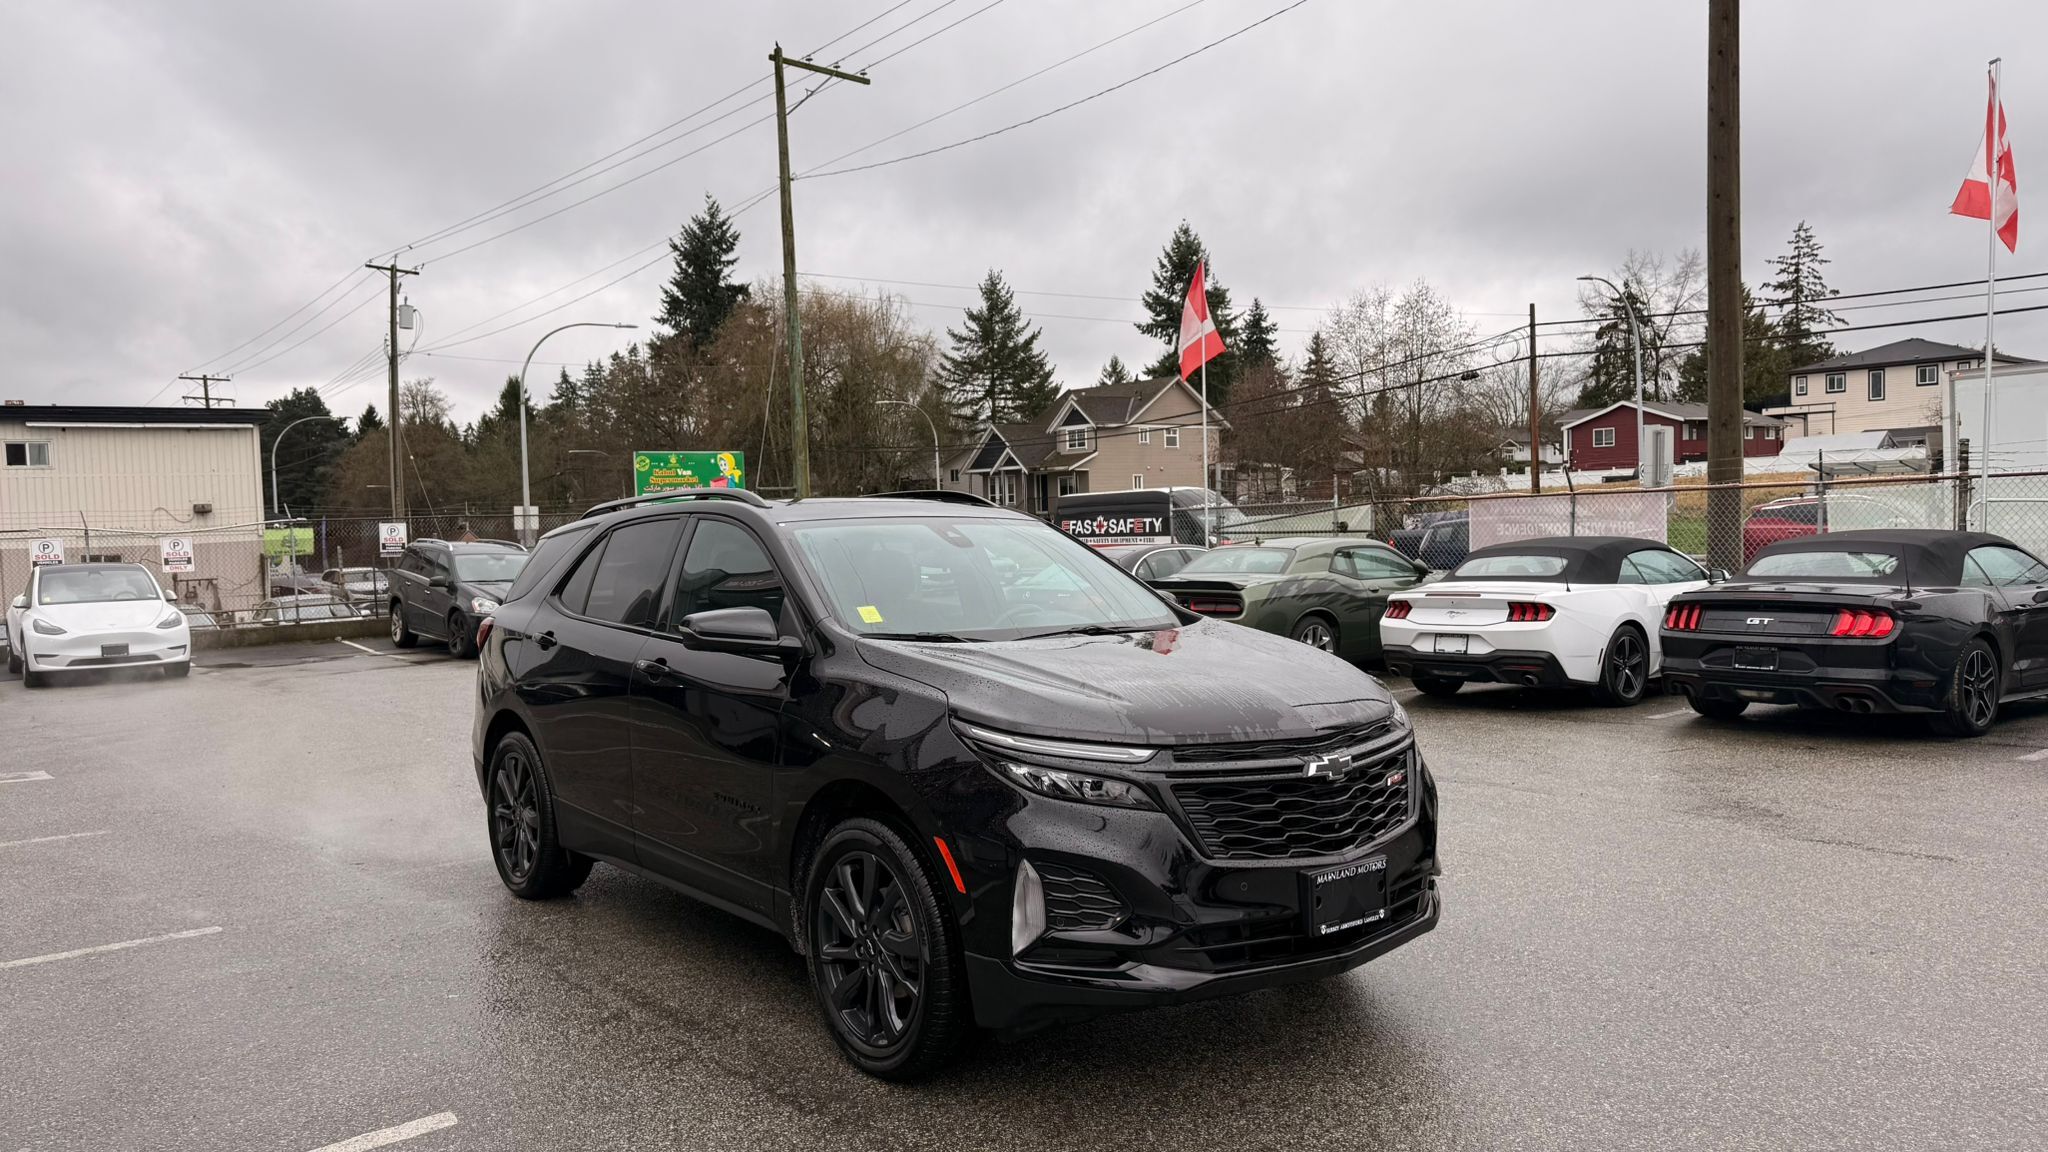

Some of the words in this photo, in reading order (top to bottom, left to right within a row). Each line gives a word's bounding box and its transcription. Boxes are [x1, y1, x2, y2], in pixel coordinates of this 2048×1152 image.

[1108, 517, 1162, 534] SAFETY
[1746, 617, 1775, 625] GT
[1316, 867, 1356, 885] MAINLAND
[1357, 859, 1387, 875] MOTORS
